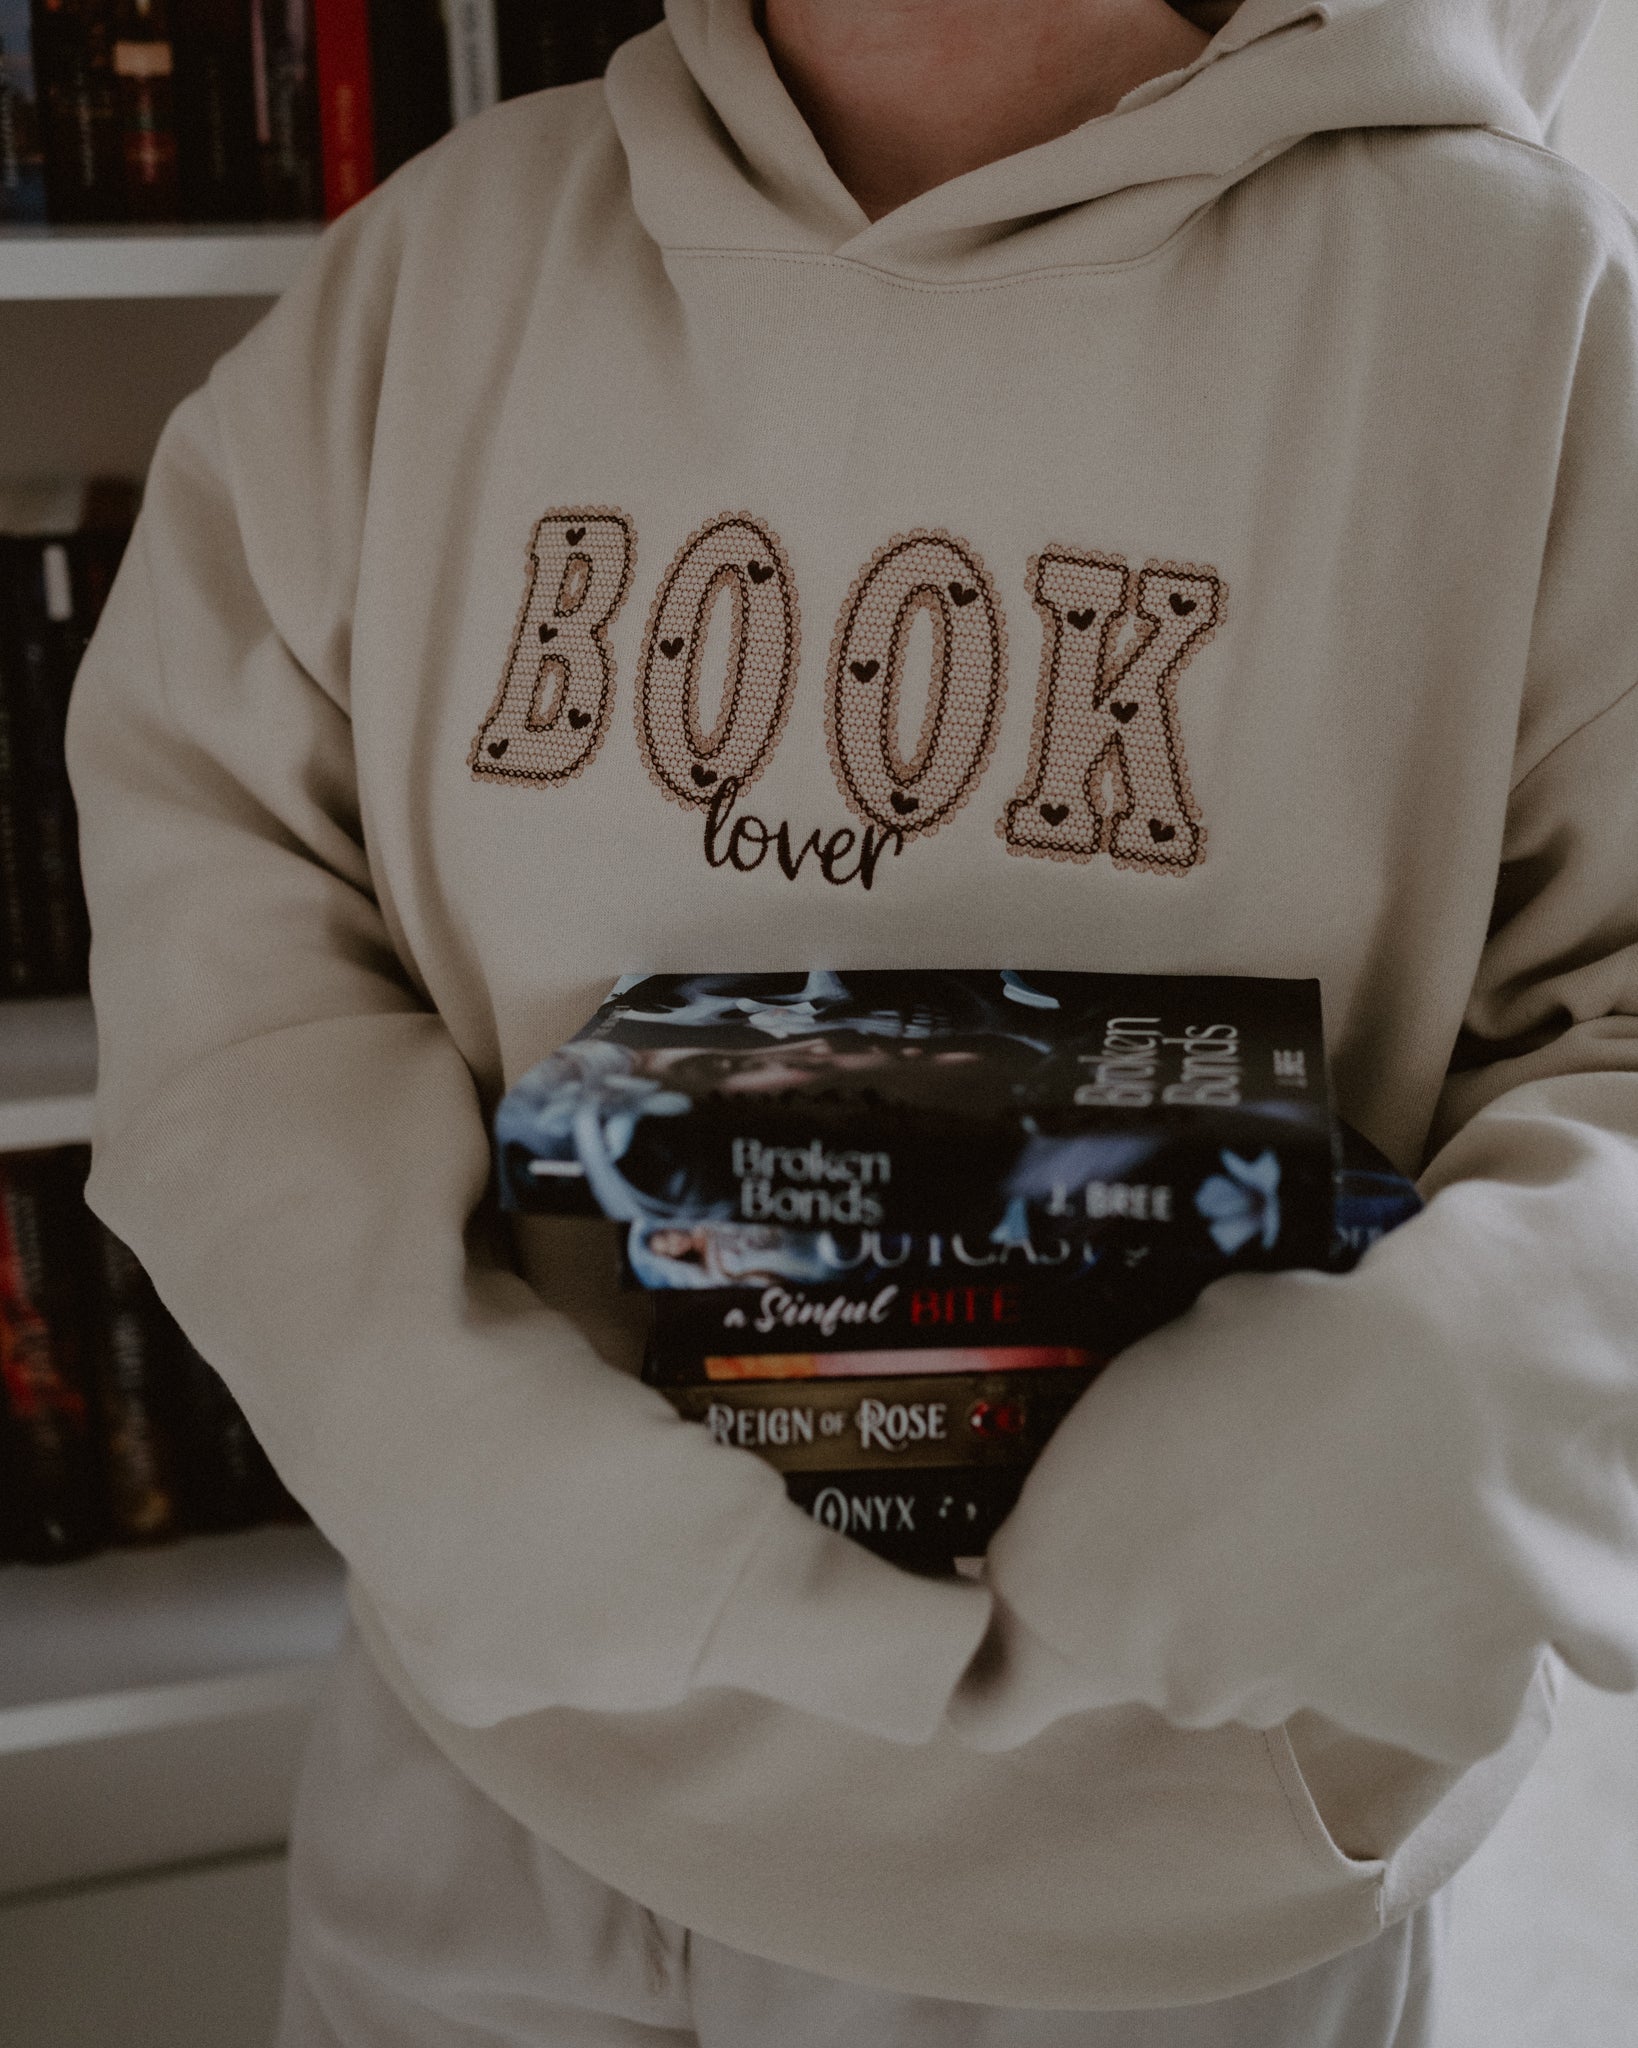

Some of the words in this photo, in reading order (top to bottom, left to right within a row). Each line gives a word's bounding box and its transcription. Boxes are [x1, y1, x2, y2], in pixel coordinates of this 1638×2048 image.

[466, 505, 1229, 877] BOOK
[704, 775, 904, 890] lover
[1073, 1016, 1163, 1107] Broken
[1161, 1023, 1243, 1107] Bonds
[731, 1136, 892, 1185] Broken
[739, 1176, 885, 1226] Bonds
[754, 1284, 899, 1337] Sinful
[910, 1283, 1021, 1326] BITE
[703, 1401, 815, 1447] REIGN
[855, 1397, 947, 1451] ROSE
[813, 1486, 916, 1535] ONYX
